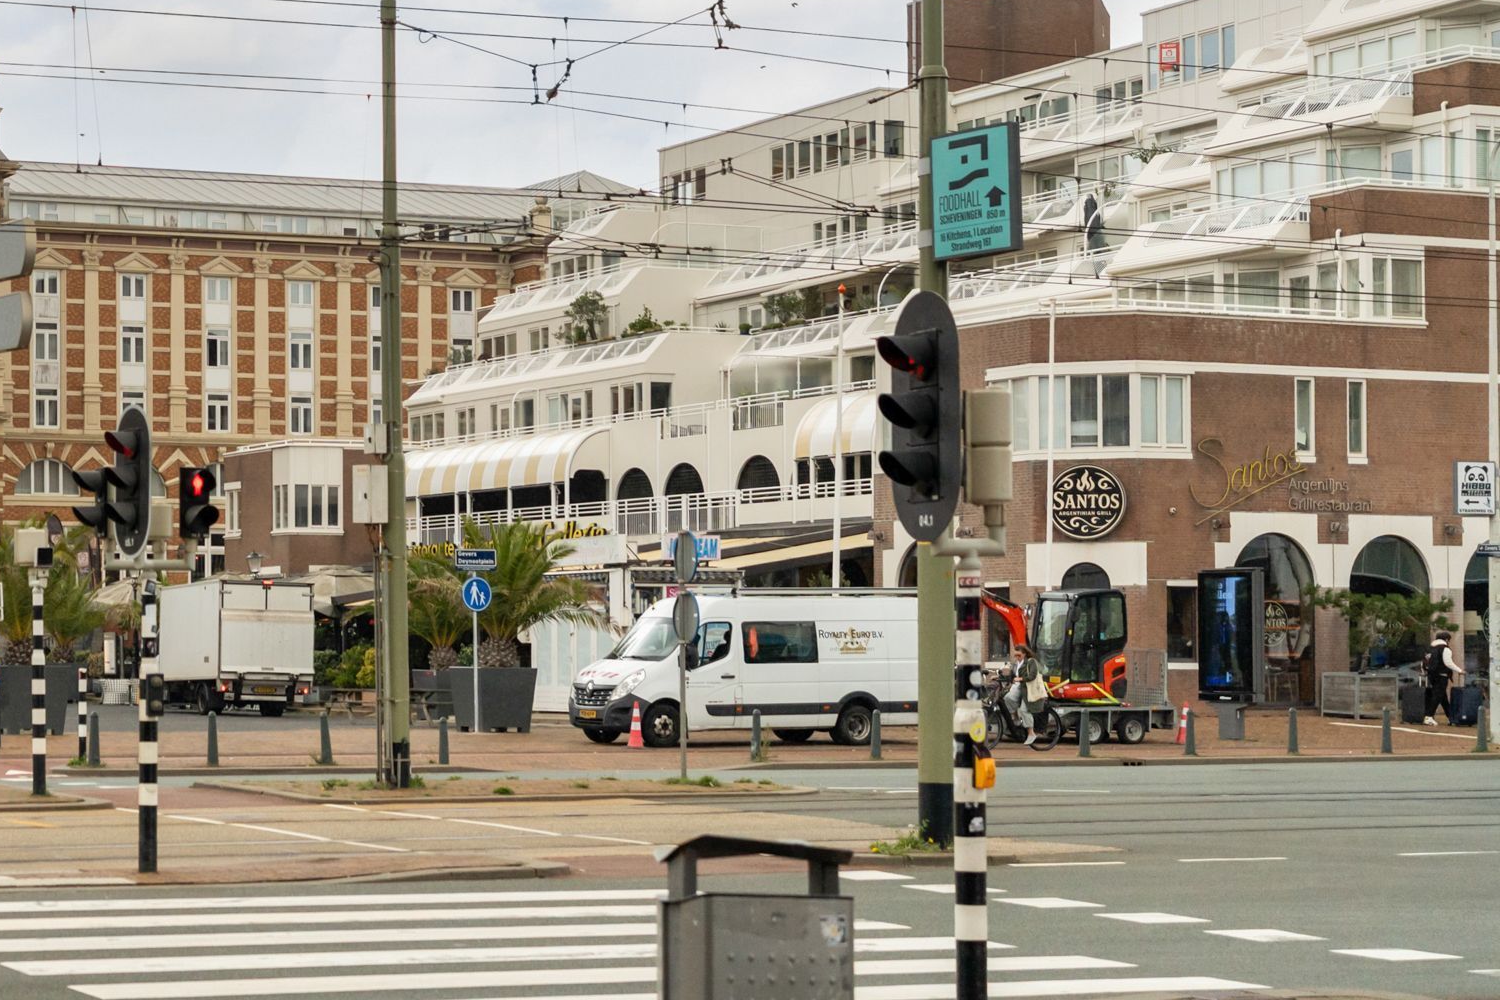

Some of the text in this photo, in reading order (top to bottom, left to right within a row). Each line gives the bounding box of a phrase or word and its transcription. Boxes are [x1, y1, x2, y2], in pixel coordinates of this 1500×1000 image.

[939, 190, 982, 213] FOODHALL
[940, 209, 982, 225] SCHEVENINGEN
[947, 230, 972, 241] Kitchens,
[977, 224, 1003, 236] Location
[951, 239, 982, 252] Strandweg
[1189, 438, 1301, 508] Santos
[1053, 491, 1120, 510] SANTOS
[1288, 497, 1372, 512] Grillrestaurant
[697, 538, 719, 558] EAM
